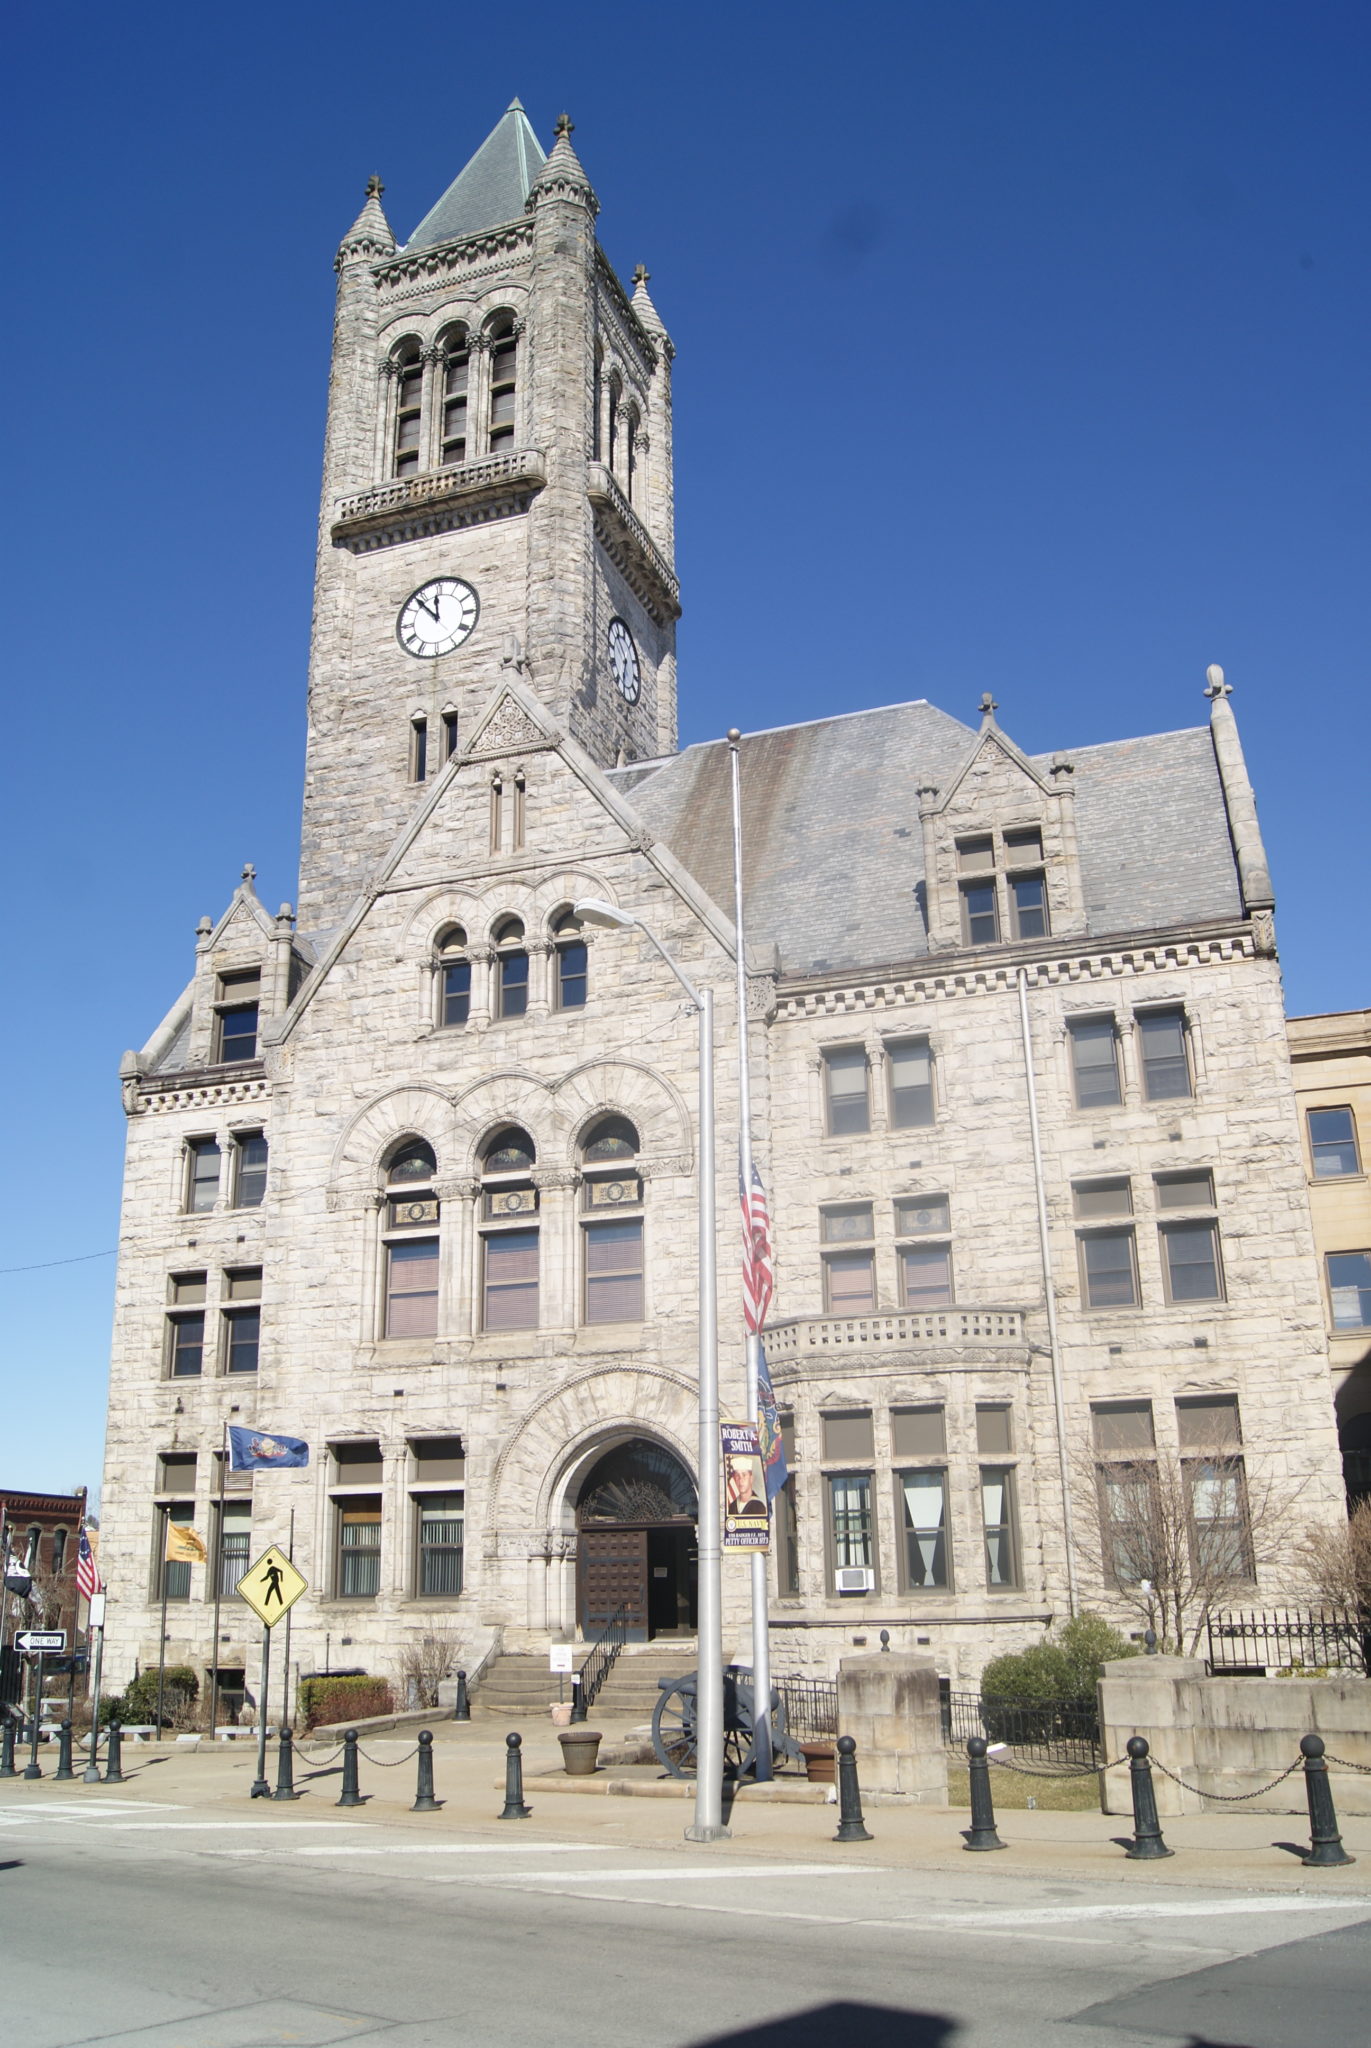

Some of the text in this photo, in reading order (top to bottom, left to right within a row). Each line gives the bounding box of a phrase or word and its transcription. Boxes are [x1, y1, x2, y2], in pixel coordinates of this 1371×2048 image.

[722, 1428, 748, 1440] ROBERT
[730, 1440, 753, 1451] SMITH
[30, 1637, 60, 1645] ONE WAY
